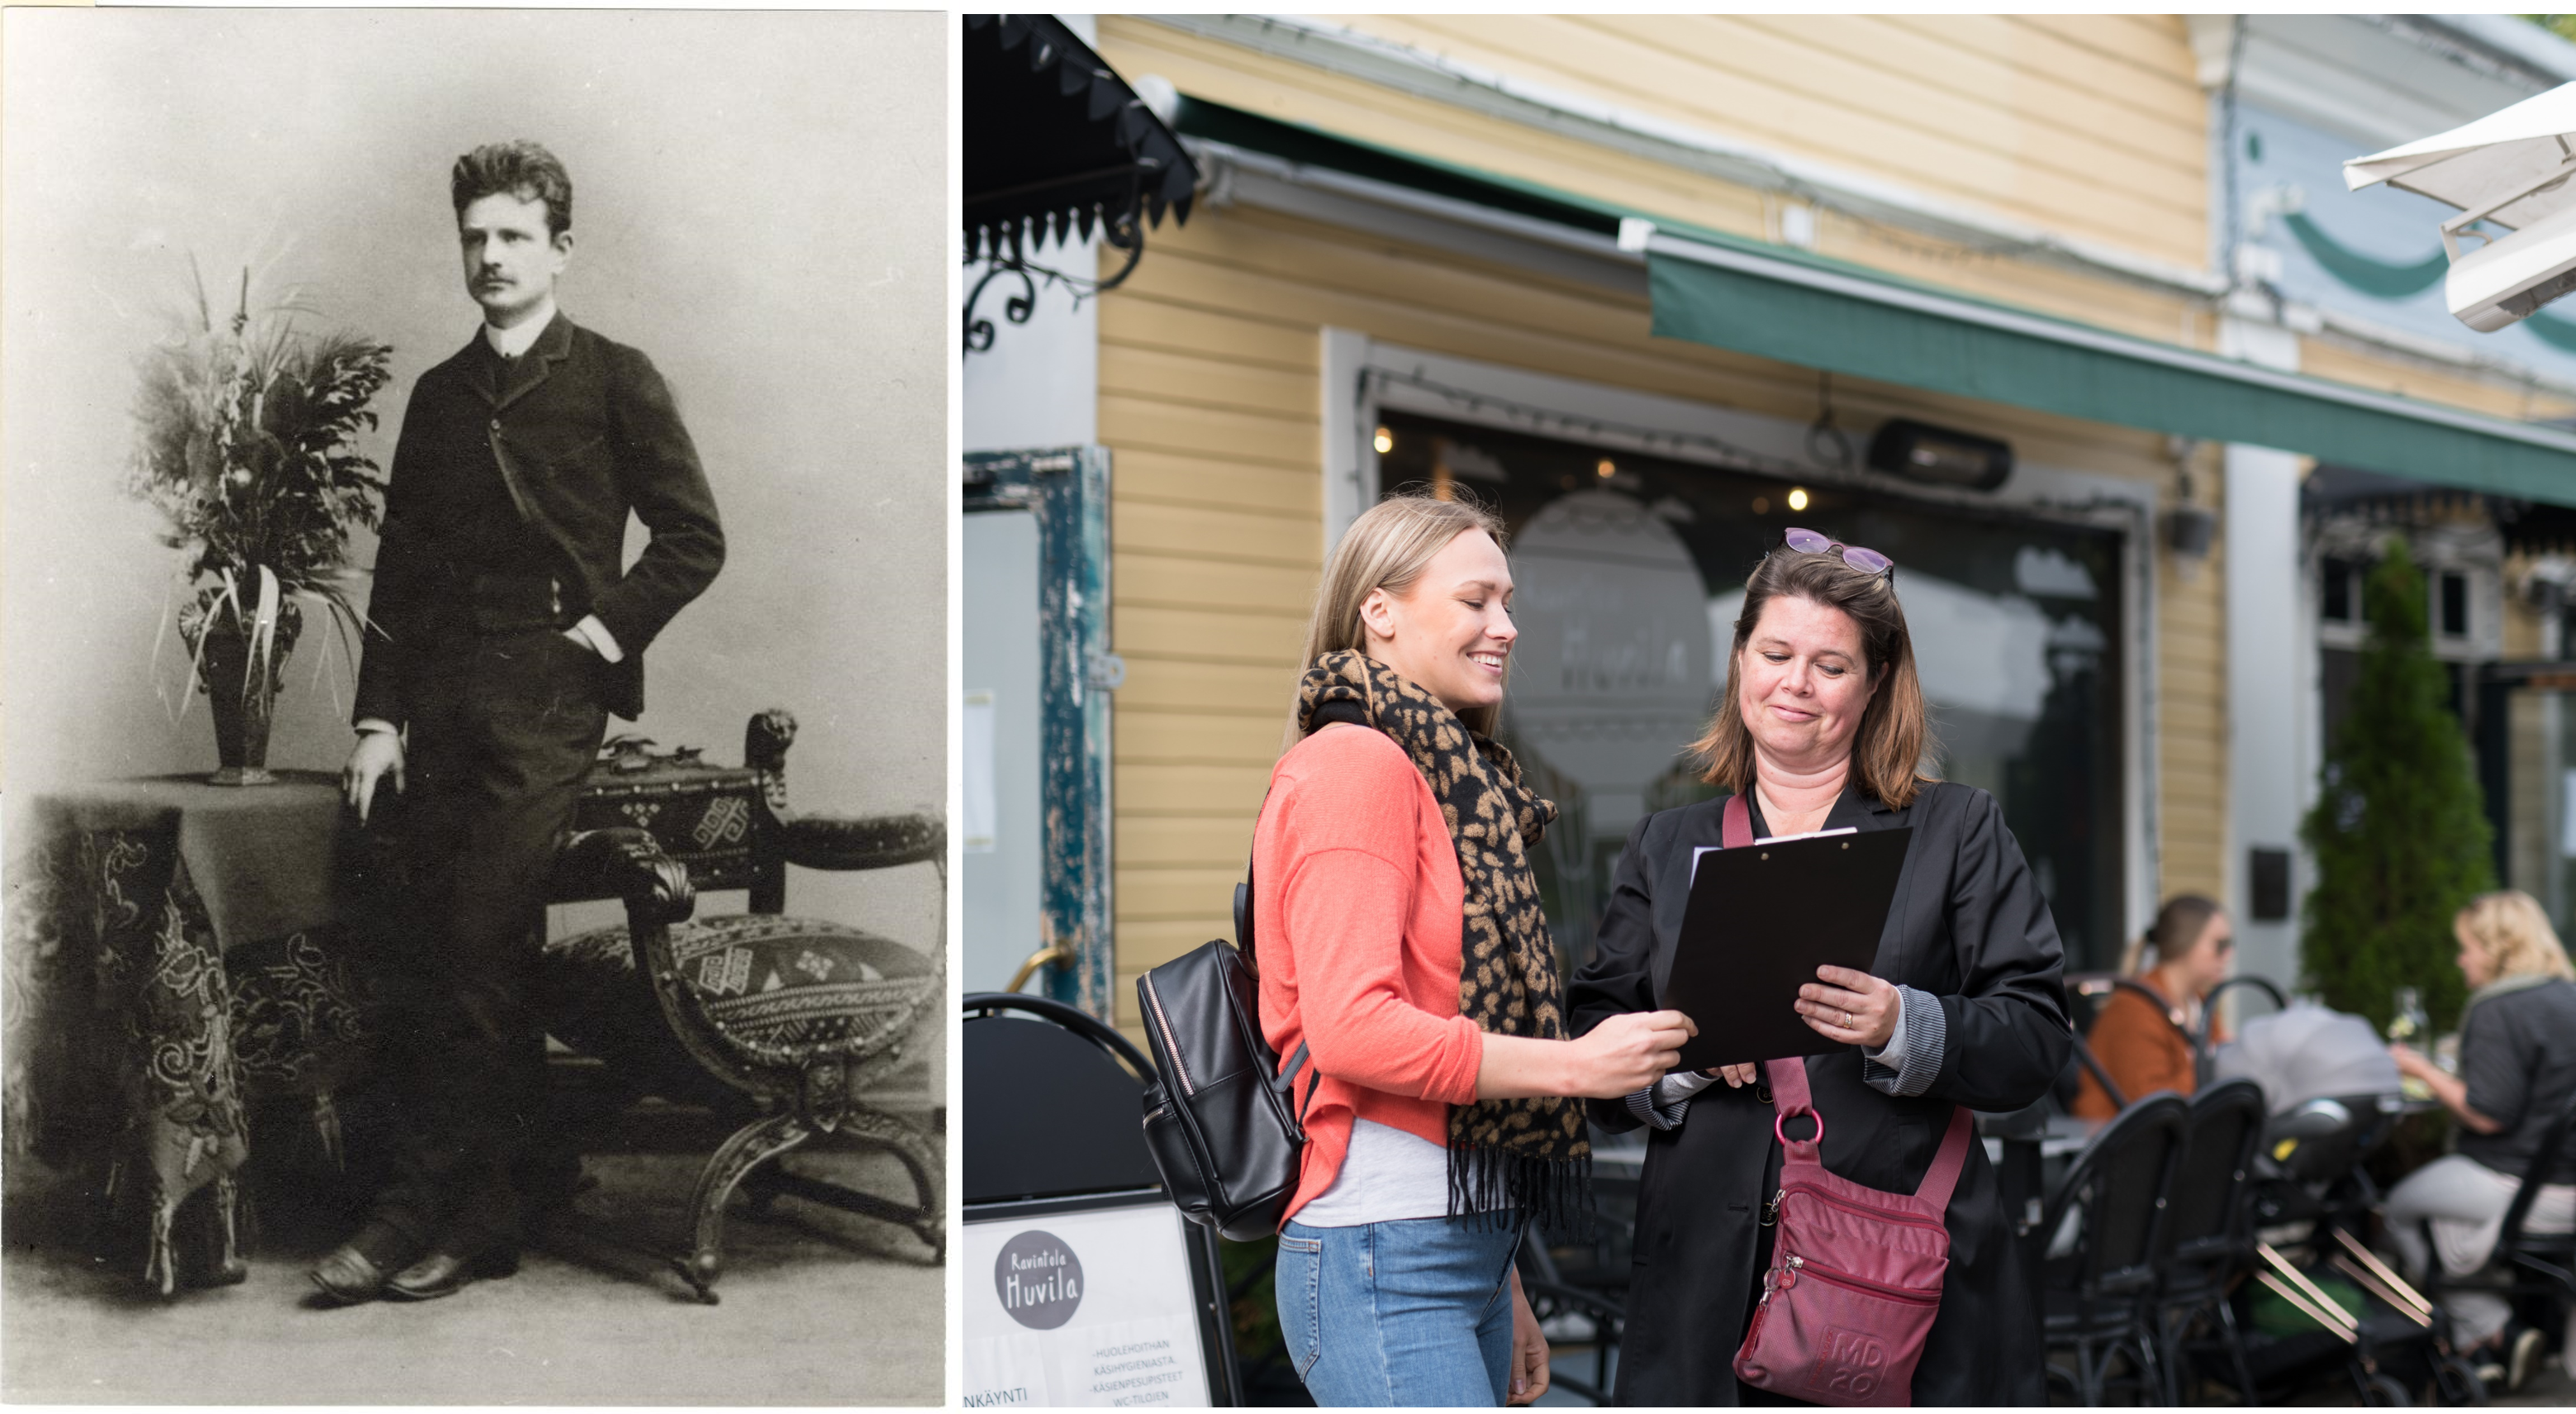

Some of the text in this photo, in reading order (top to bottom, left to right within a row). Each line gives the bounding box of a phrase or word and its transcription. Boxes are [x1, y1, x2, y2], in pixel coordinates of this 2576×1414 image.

[1011, 1249, 1067, 1271] Ravintola
[1006, 1267, 1078, 1310] Huvila
[1832, 1332, 1883, 1369] MD
